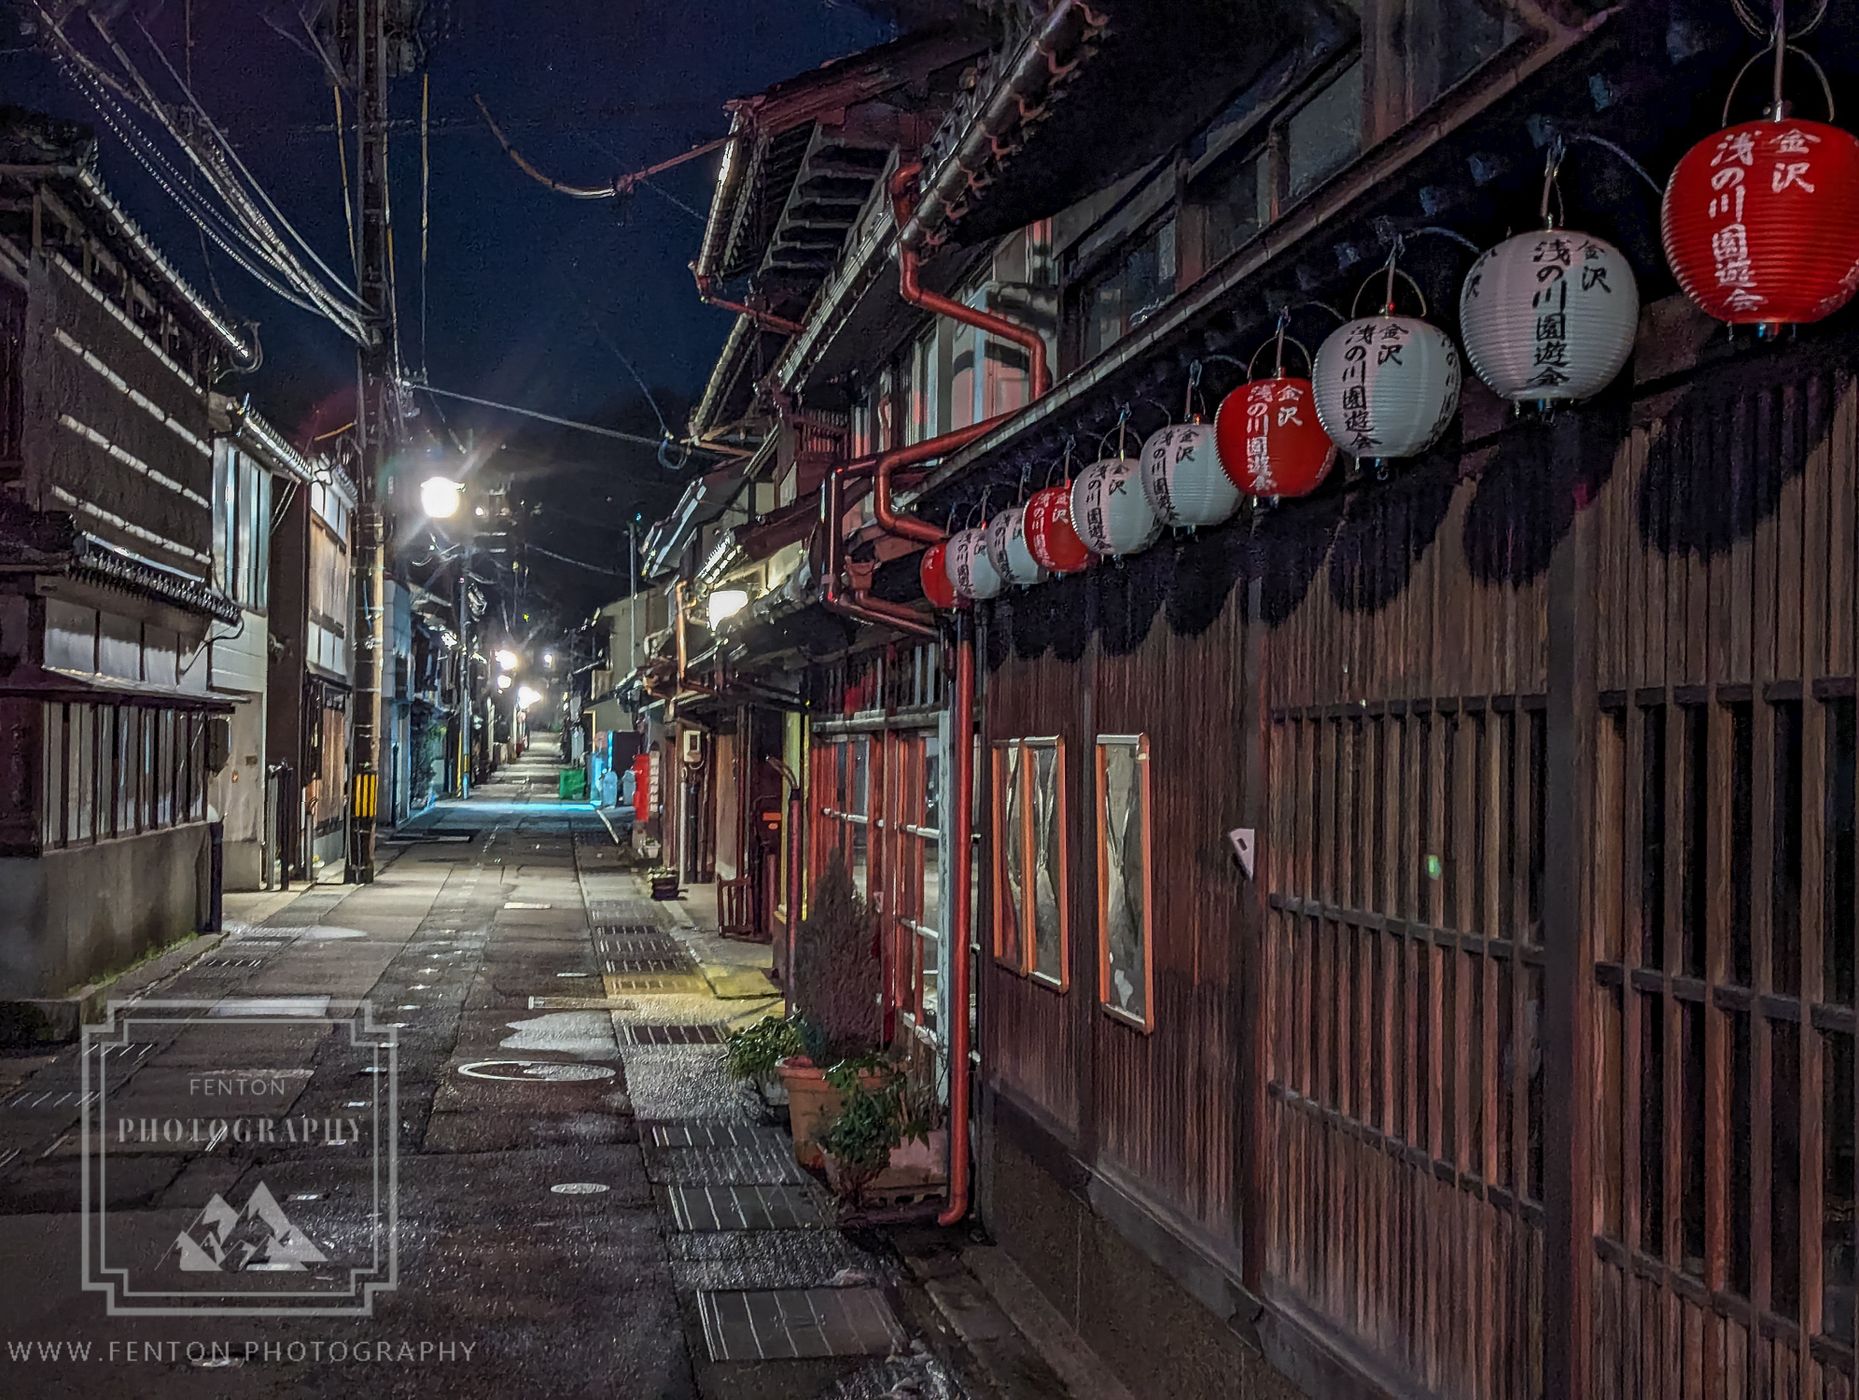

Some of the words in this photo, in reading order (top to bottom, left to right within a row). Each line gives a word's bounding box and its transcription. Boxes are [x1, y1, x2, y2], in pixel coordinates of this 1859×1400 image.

[1769, 128, 1821, 193] 金沢
[1709, 130, 1769, 312] 浅の川園遊会
[1575, 239, 1612, 294] 金沢
[1379, 323, 1409, 366] 金沢
[1526, 238, 1572, 388] 浅の川園遊会
[1277, 385, 1304, 427] 金沢
[1342, 324, 1383, 449] 浅の川園遊会
